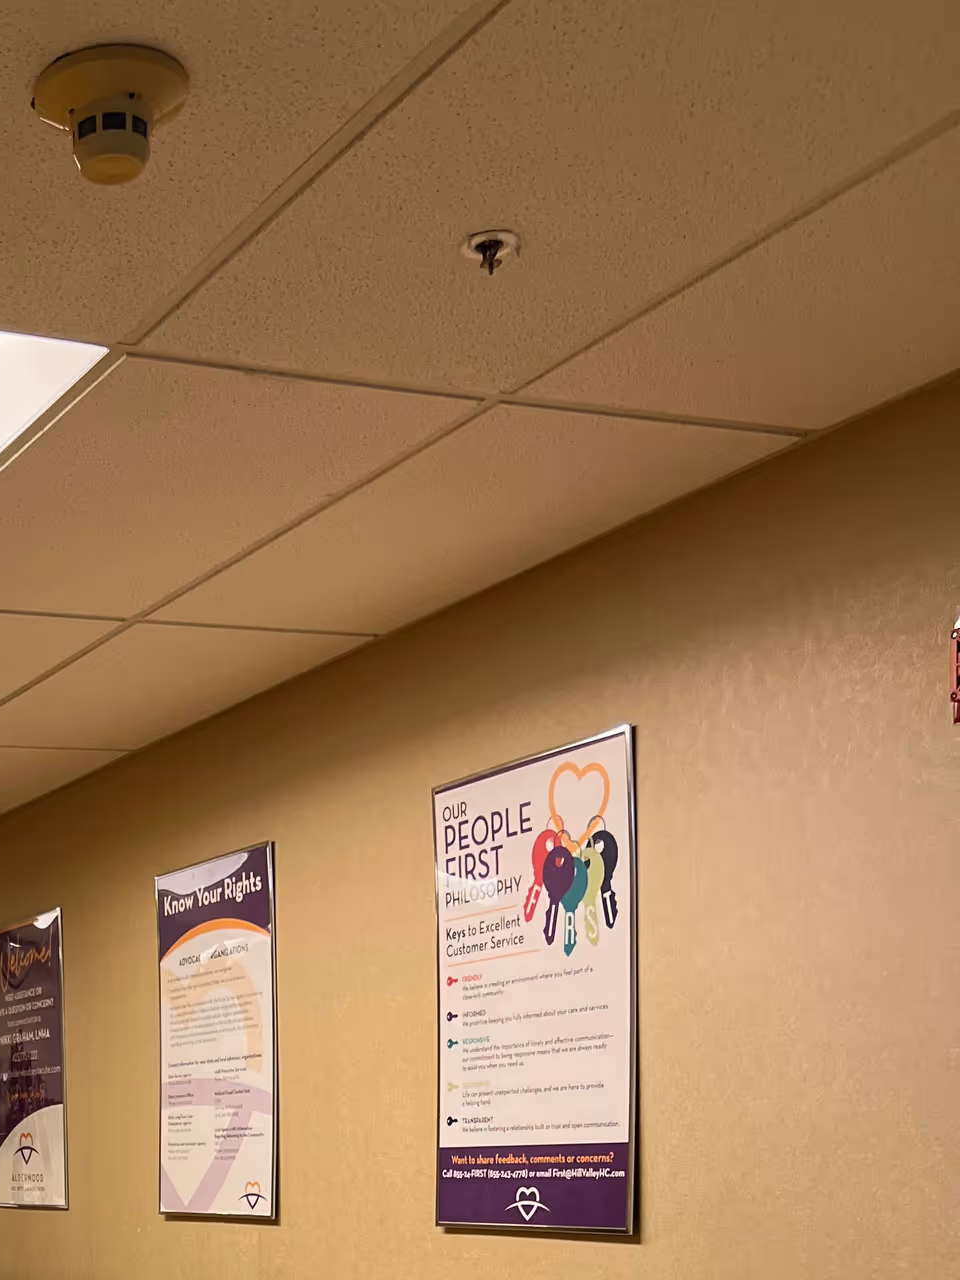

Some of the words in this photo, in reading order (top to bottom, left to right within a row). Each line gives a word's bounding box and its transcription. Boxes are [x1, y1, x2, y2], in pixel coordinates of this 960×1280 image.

[442, 801, 467, 822] OUR
[444, 801, 533, 855] PEOPLE
[445, 844, 504, 887] FIRST
[164, 895, 194, 916] Know
[196, 885, 222, 907] Your
[224, 872, 262, 902] Rights
[445, 875, 522, 909] PHILOSOPHY
[446, 927, 466, 942] Keys
[468, 924, 477, 937] to
[479, 914, 521, 935] Excellent
[446, 940, 489, 958] Customer
[490, 932, 525, 950] Service
[451, 1154, 468, 1164] Want
[468, 1154, 476, 1164] to
[476, 1154, 494, 1164] share
[495, 1152, 529, 1165] feedback,
[530, 1153, 566, 1164] comments
[566, 1155, 575, 1163] or
[576, 1152, 614, 1163] concerns?
[12, 1173, 44, 1182] ALDERWOOD
[442, 1168, 452, 1178] Call
[453, 1168, 487, 1178] 855-24-FIRST
[536, 1168, 552, 1178] email
[552, 1168, 626, 1180] First@HillValleyHC.com
